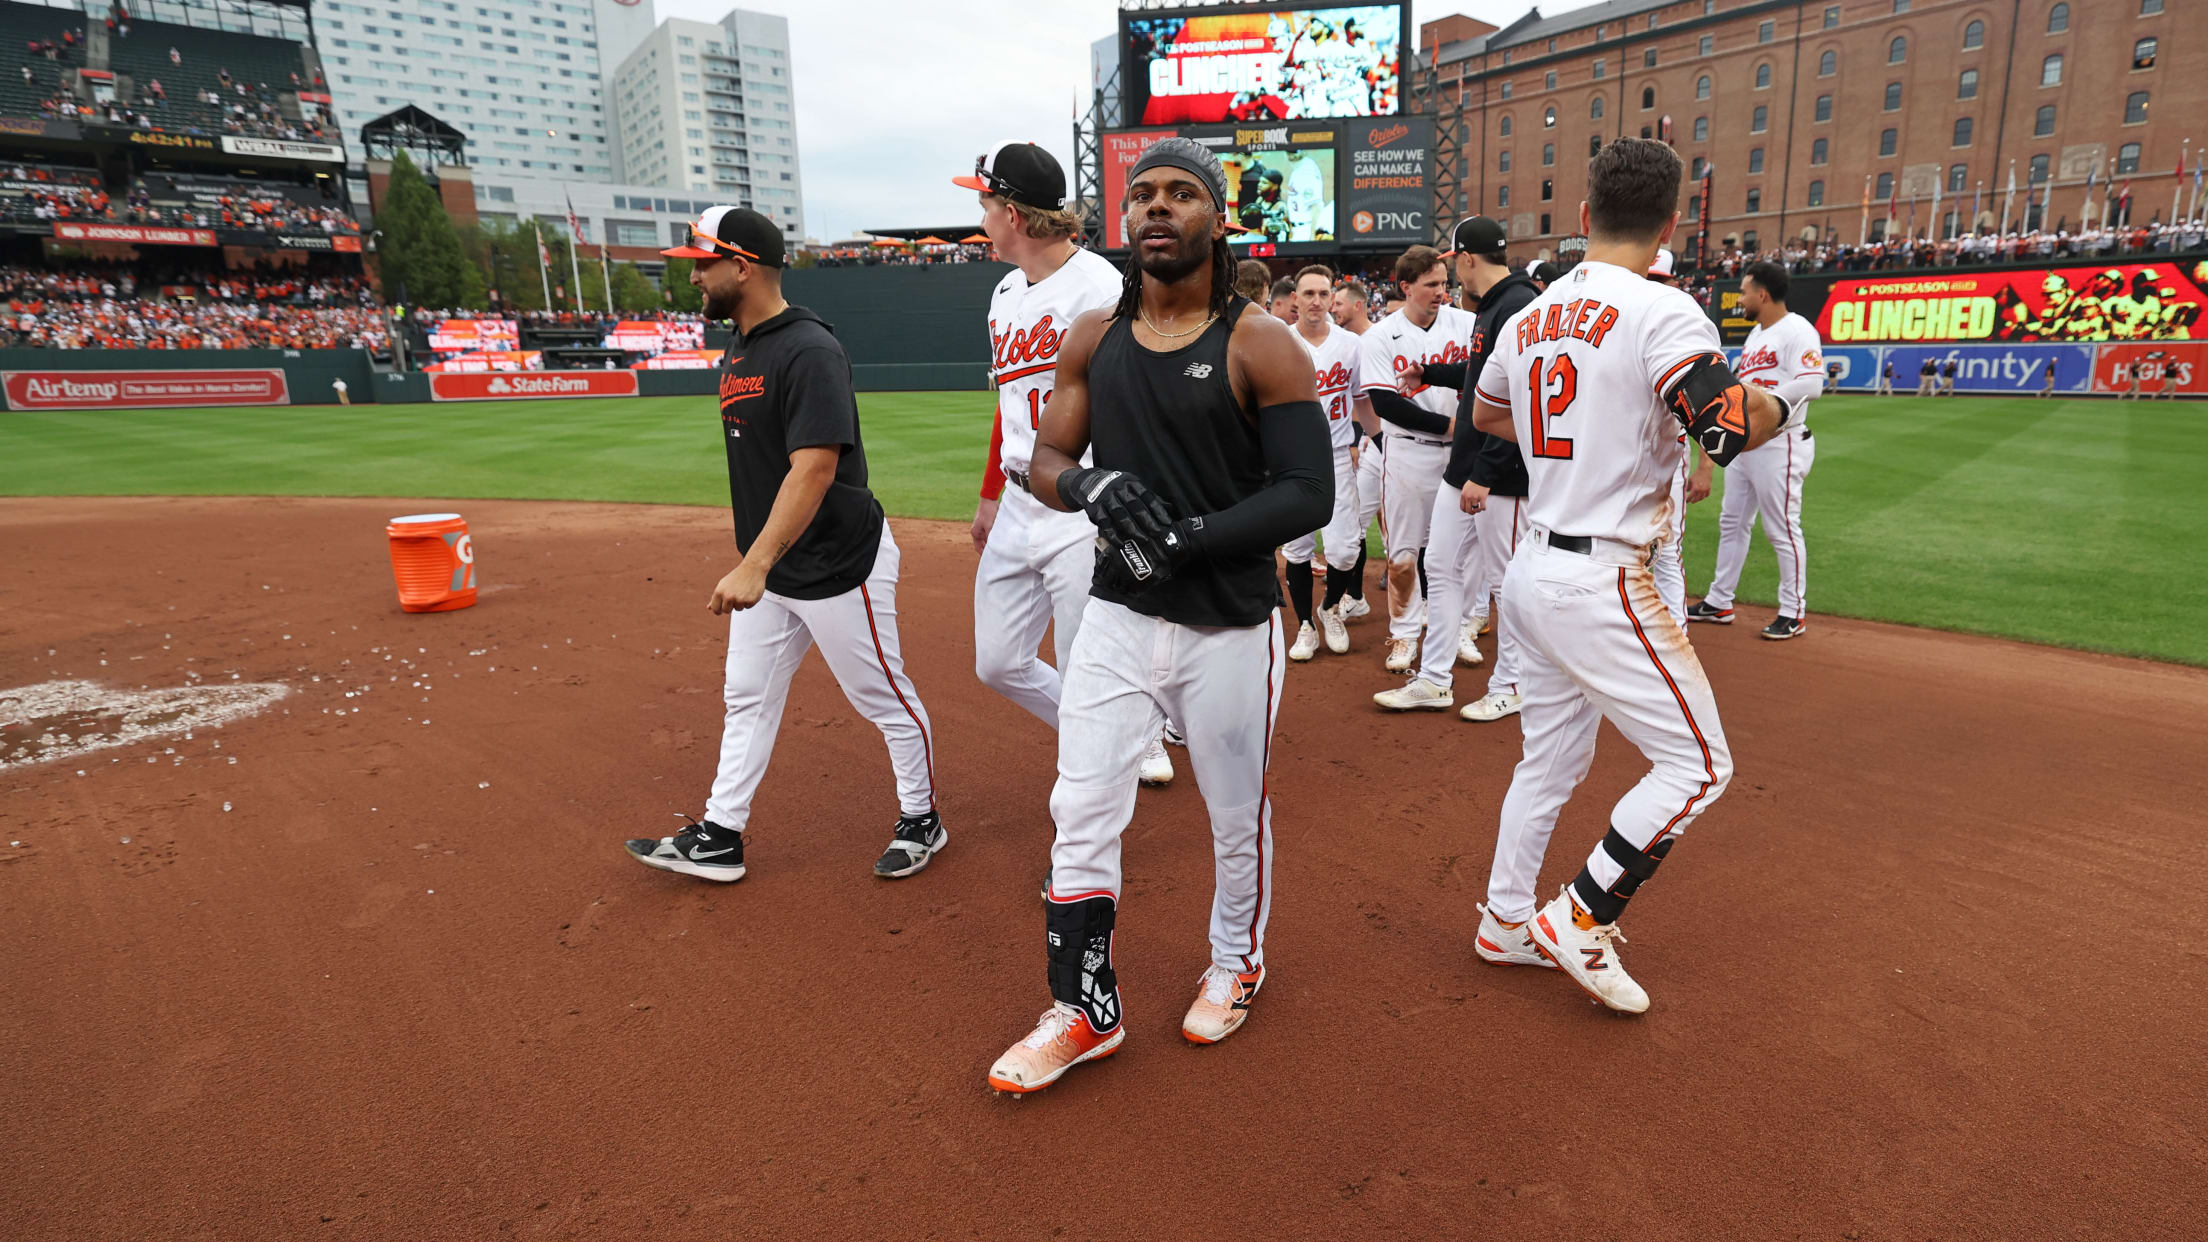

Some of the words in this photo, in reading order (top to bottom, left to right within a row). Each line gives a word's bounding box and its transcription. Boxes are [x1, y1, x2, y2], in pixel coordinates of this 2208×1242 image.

[1149, 53, 1282, 97] CLINCHED
[1110, 137, 1138, 150] This
[1118, 152, 1138, 163] For
[1354, 150, 1376, 162] SEE
[1377, 149, 1405, 161] HOW
[1405, 148, 1424, 160] WE
[1354, 164, 1378, 176] CAN
[1380, 163, 1412, 175] MAKE
[1413, 162, 1423, 174] A
[1353, 176, 1424, 189] DIFFERENCE
[1376, 211, 1422, 230] PNC
[1869, 281, 1951, 295] POSTSEASON
[1517, 298, 1619, 355] FRAZIER
[1830, 296, 1997, 341] CLINCHED
[26, 378, 118, 401] Airtemp
[1330, 394, 1347, 420] 21
[1528, 352, 1578, 460] 12
